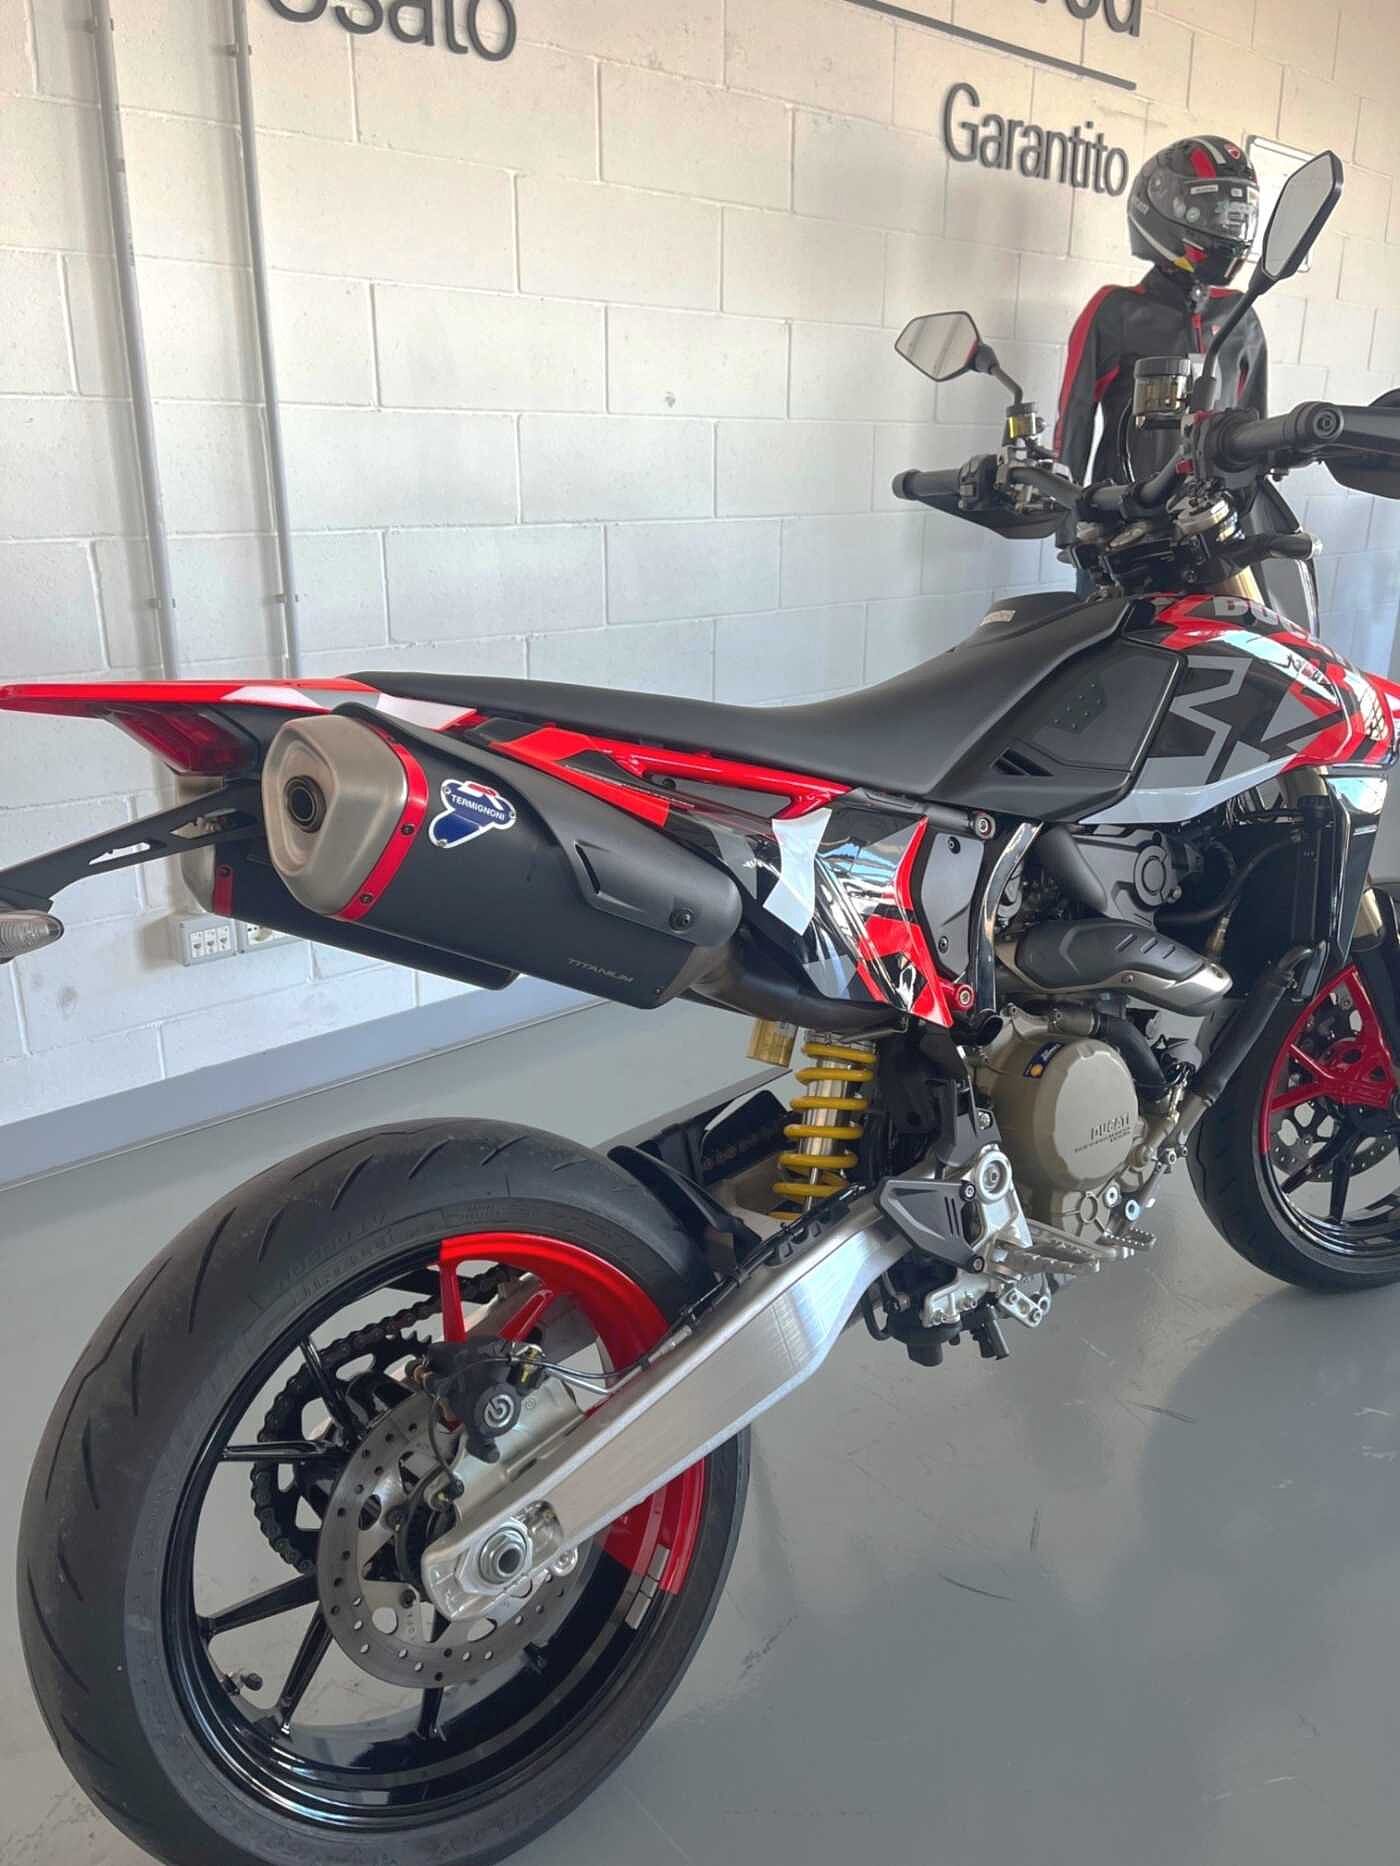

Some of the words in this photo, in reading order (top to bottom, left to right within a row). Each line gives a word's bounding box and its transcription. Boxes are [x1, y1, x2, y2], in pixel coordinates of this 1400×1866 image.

[268, 0, 517, 61] sato
[943, 82, 1129, 197] Garantito
[450, 793, 505, 821] TERMIGNONI
